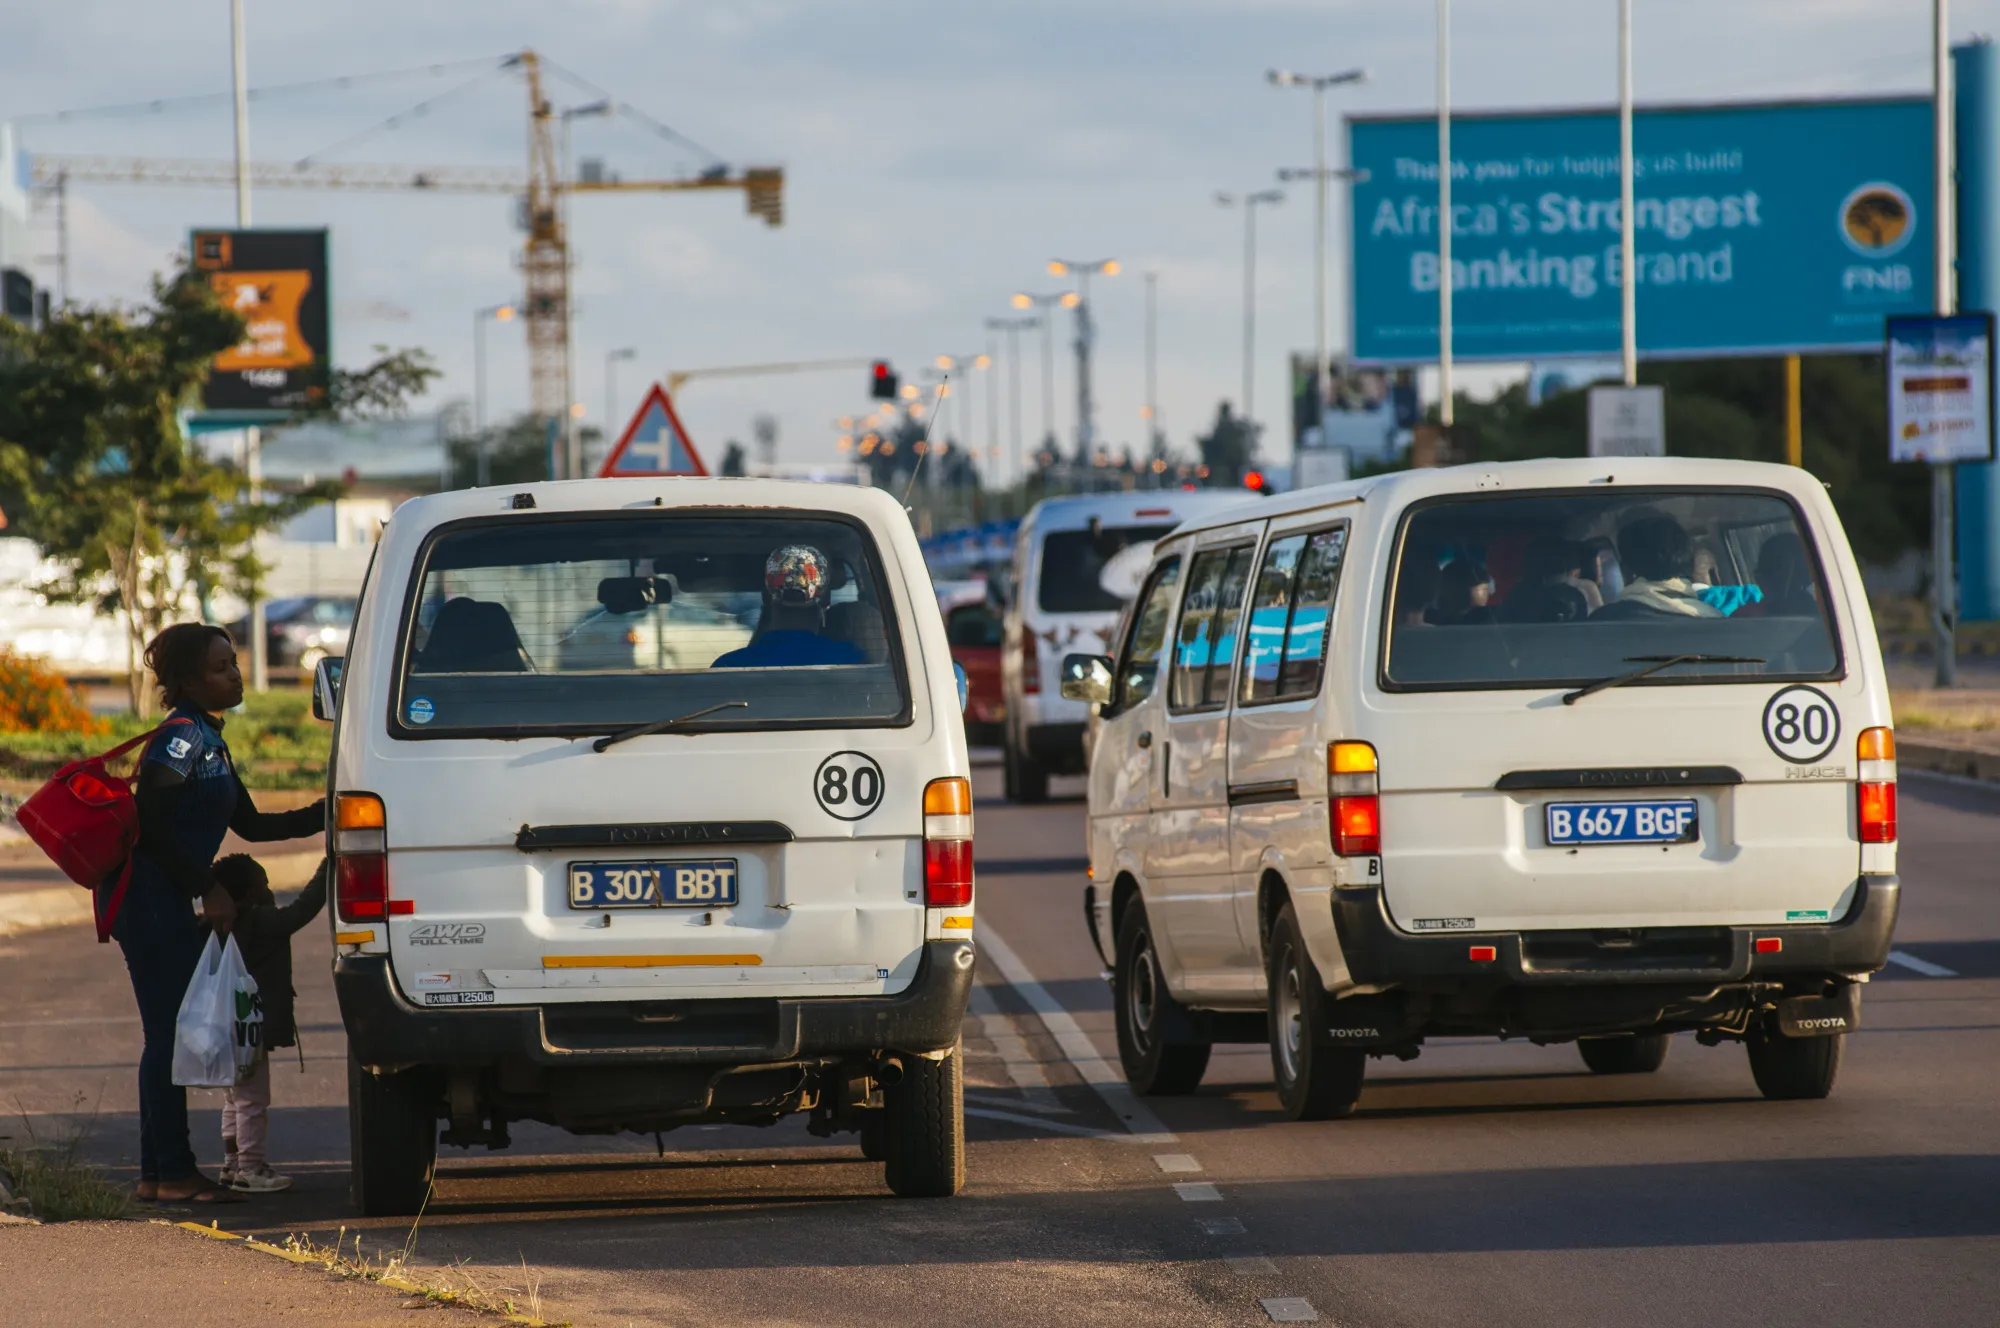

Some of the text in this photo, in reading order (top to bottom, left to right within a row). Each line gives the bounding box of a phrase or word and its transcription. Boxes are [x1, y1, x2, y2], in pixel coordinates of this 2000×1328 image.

[1475, 160, 1519, 184] you
[1684, 149, 1743, 173] build
[1371, 188, 1762, 240] Afrca's Strongest
[1410, 241, 1732, 298] Banking Brand
[1843, 264, 1913, 294] FNB
[1774, 703, 1829, 745] 80
[1579, 769, 1670, 784] TOYOTA
[1785, 766, 1847, 779] HIACE
[821, 765, 879, 806] 80
[1552, 809, 1573, 838] B
[1577, 808, 1628, 836] 667
[608, 825, 710, 842] TOYOTA
[1368, 859, 1379, 876] B
[573, 868, 735, 901] B 307 BBT
[409, 922, 486, 939] 4WD
[410, 938, 447, 946] FULL
[459, 992, 493, 1003] 1250kg
[1796, 1017, 1846, 1029] TOYOTA
[1329, 1028, 1379, 1038] TOYOTA
